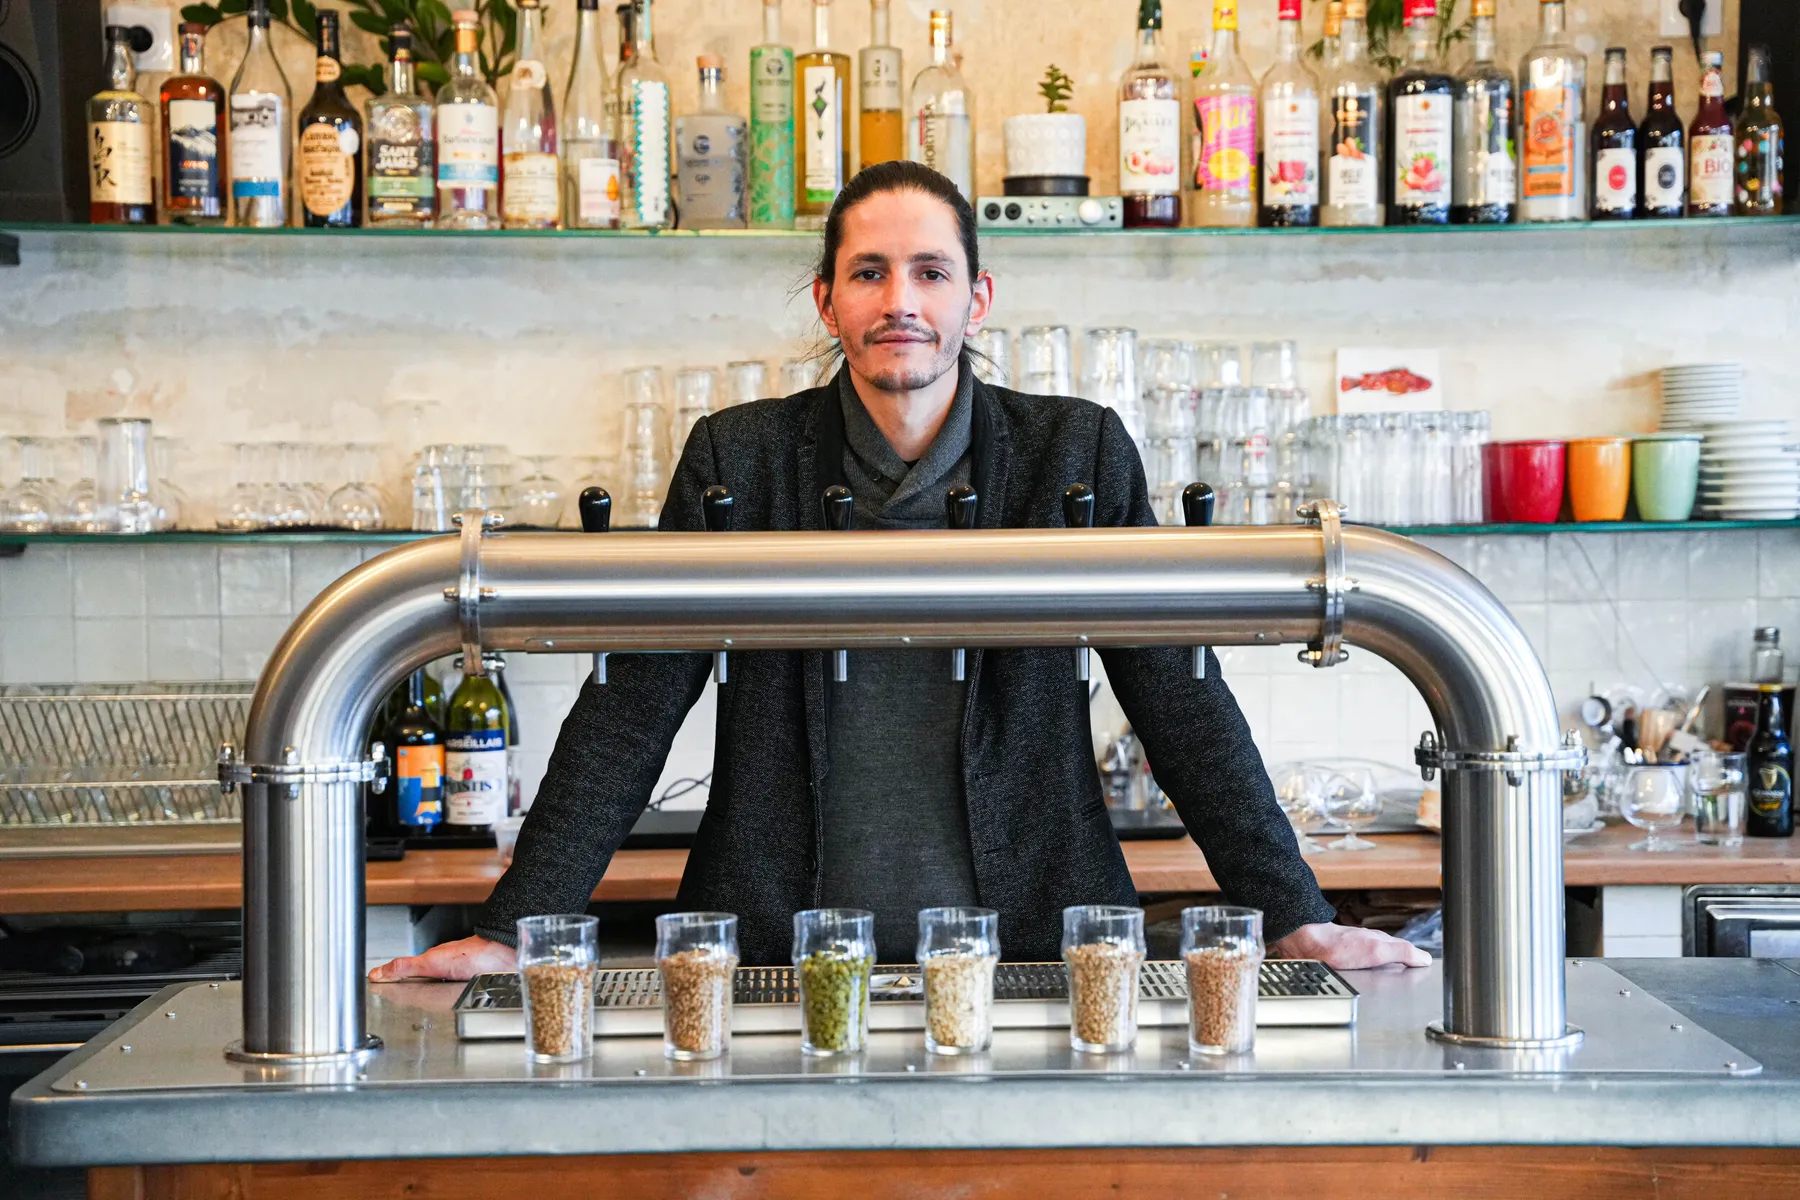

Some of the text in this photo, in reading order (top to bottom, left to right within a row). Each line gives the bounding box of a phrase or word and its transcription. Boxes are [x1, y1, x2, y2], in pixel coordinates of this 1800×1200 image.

[379, 144, 418, 157] SAINT
[375, 156, 419, 171] JAMES
[1705, 159, 1732, 174] BIO
